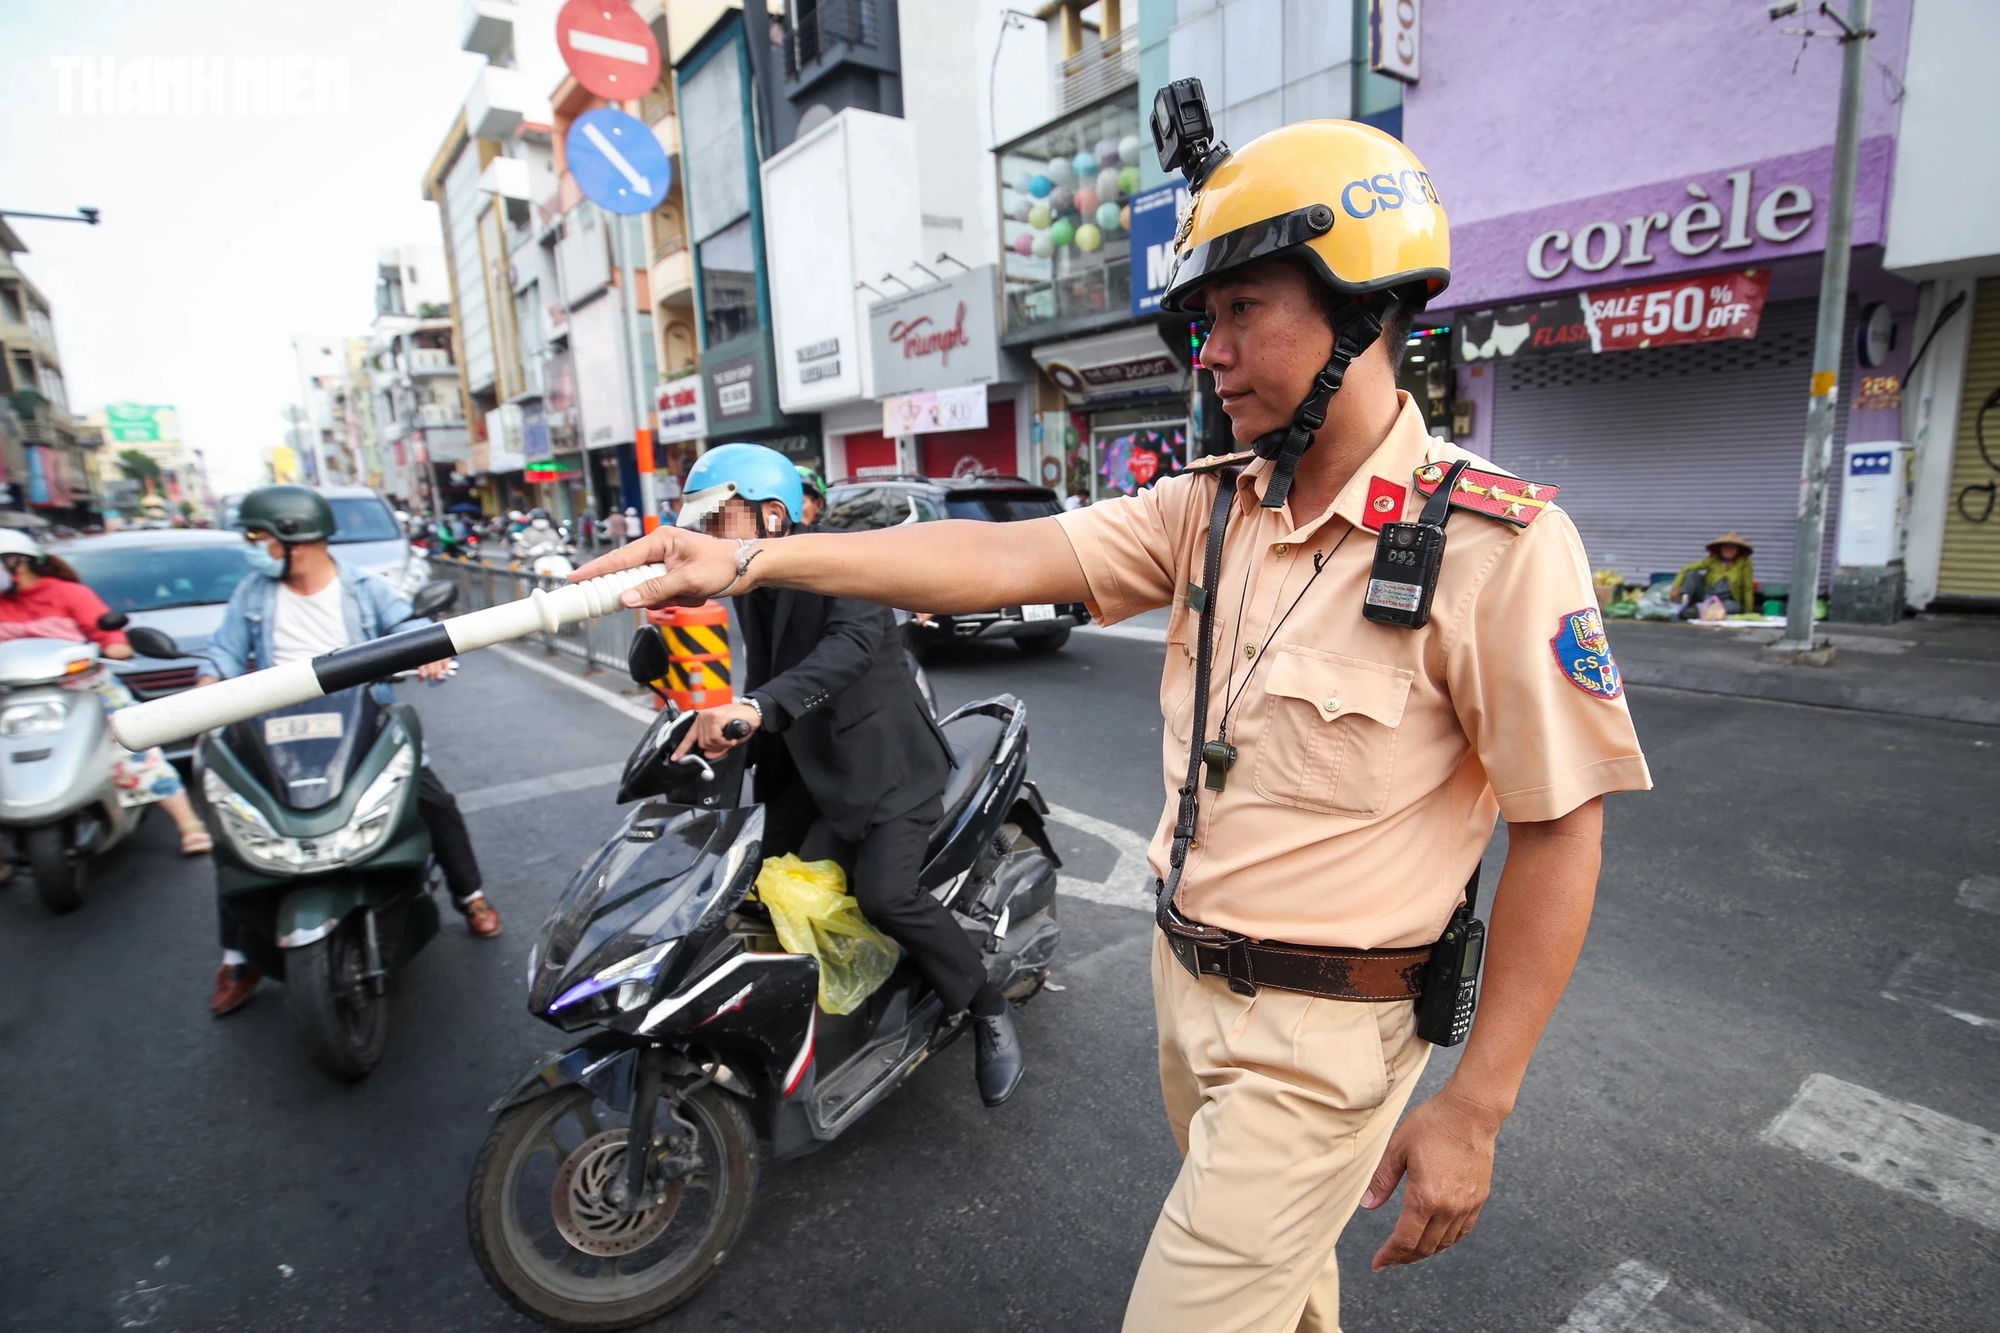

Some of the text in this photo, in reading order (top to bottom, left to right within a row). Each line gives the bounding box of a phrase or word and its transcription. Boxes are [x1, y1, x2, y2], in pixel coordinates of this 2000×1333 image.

[1526, 169, 1814, 280] corèle
[1592, 294, 1643, 320] SALE
[1706, 303, 1750, 329] OFF
[888, 299, 969, 368] Triumph
[1387, 549, 1416, 567] 092
